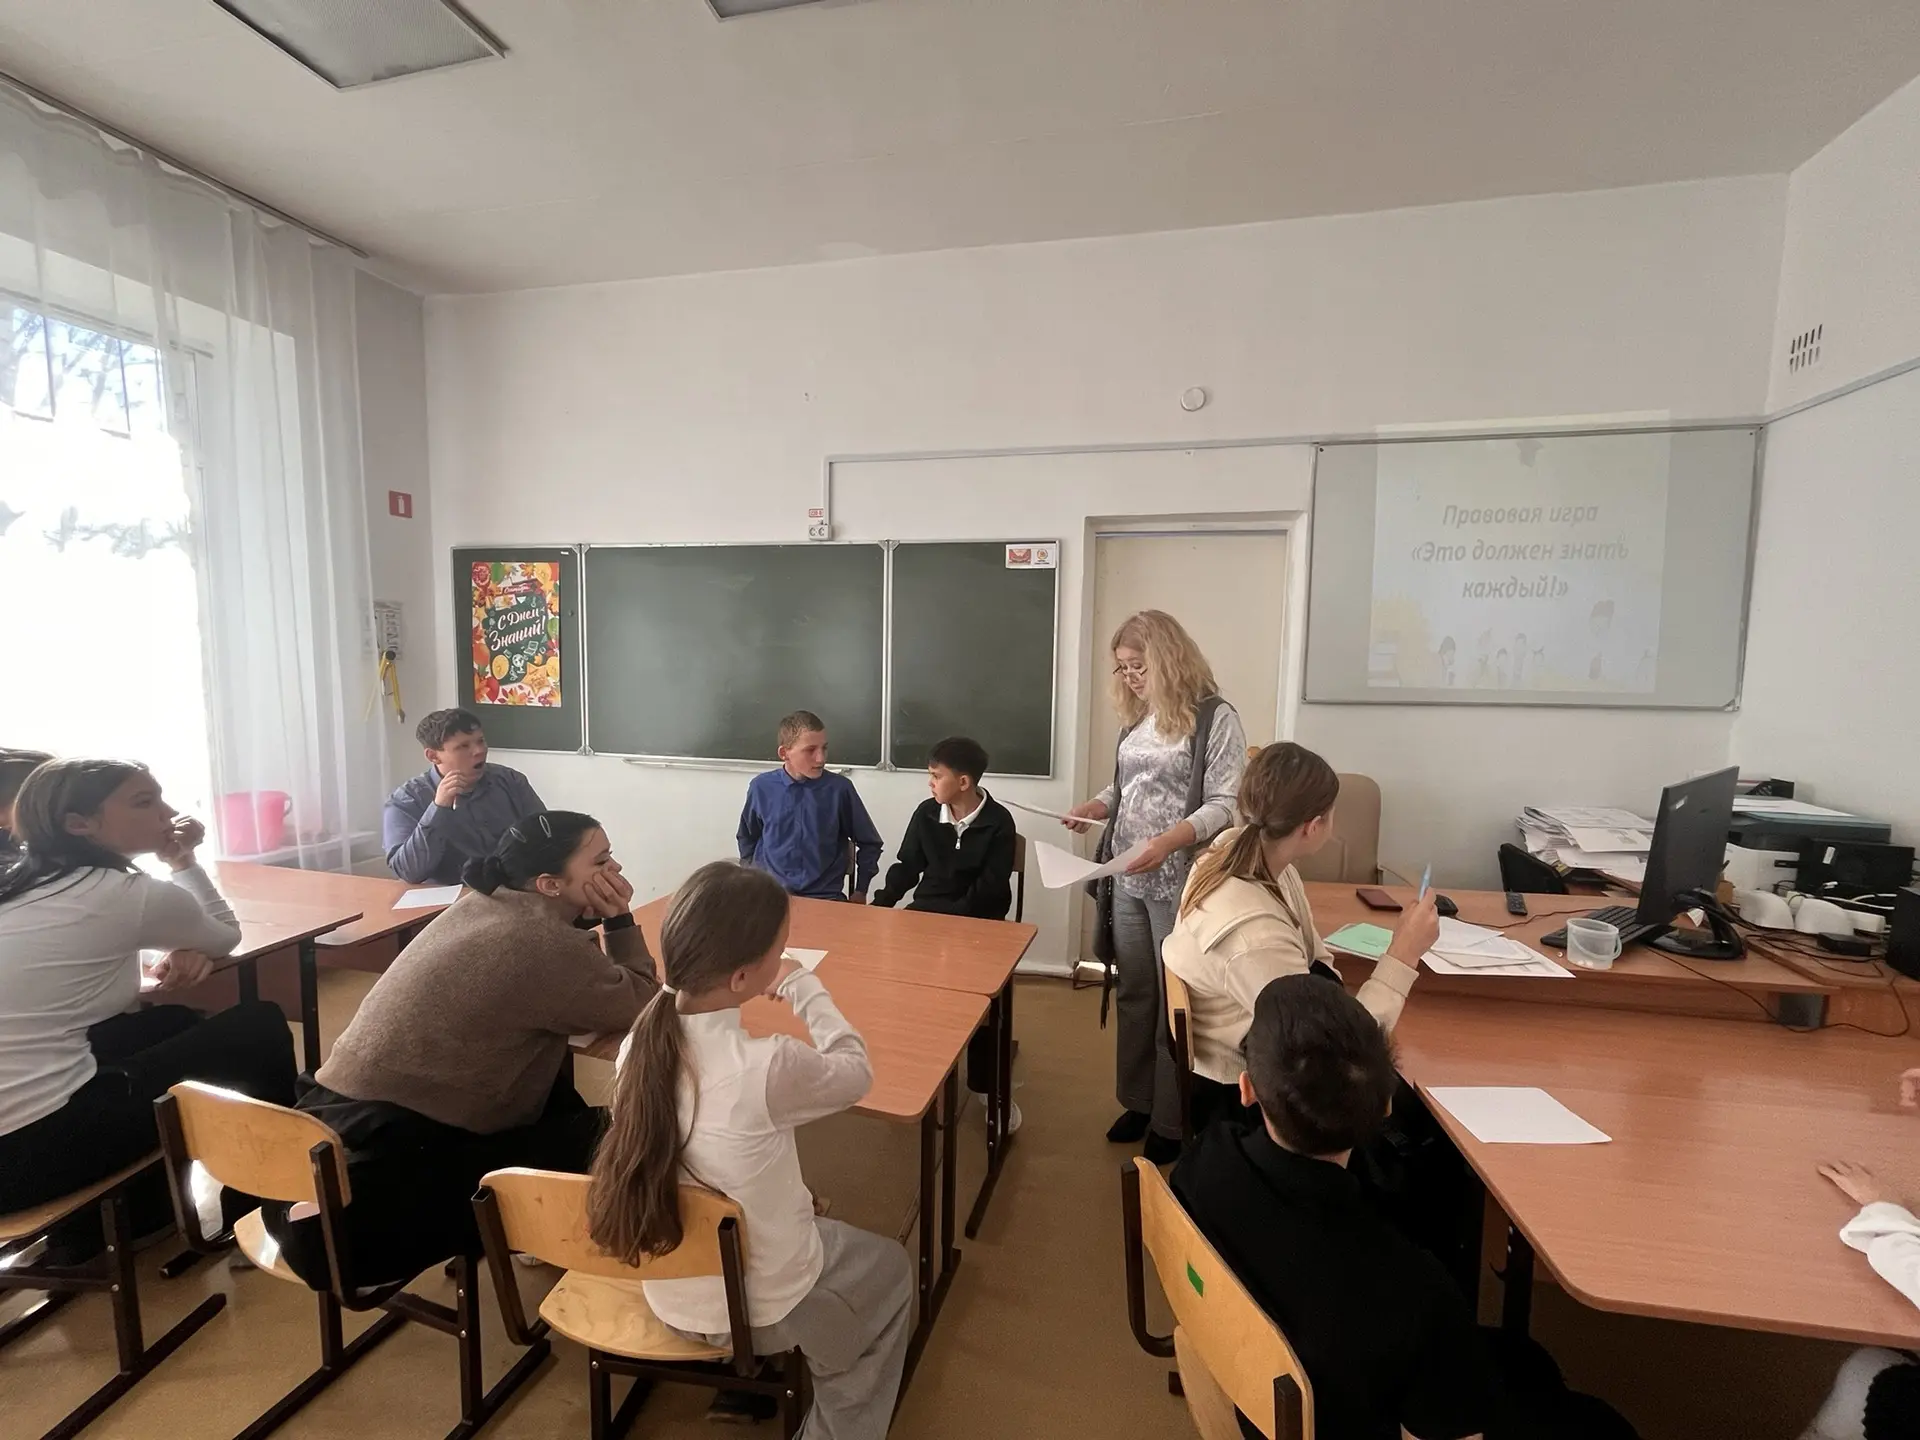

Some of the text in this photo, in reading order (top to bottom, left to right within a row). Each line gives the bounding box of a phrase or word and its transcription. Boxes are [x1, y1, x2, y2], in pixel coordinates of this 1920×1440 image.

[1442, 504, 1600, 529] Правовая игра
[1411, 538, 1630, 562] «Это должен знать
[1462, 574, 1569, 599] каждый!»
[488, 615, 546, 652] Знаний!
[497, 613, 507, 630] С
